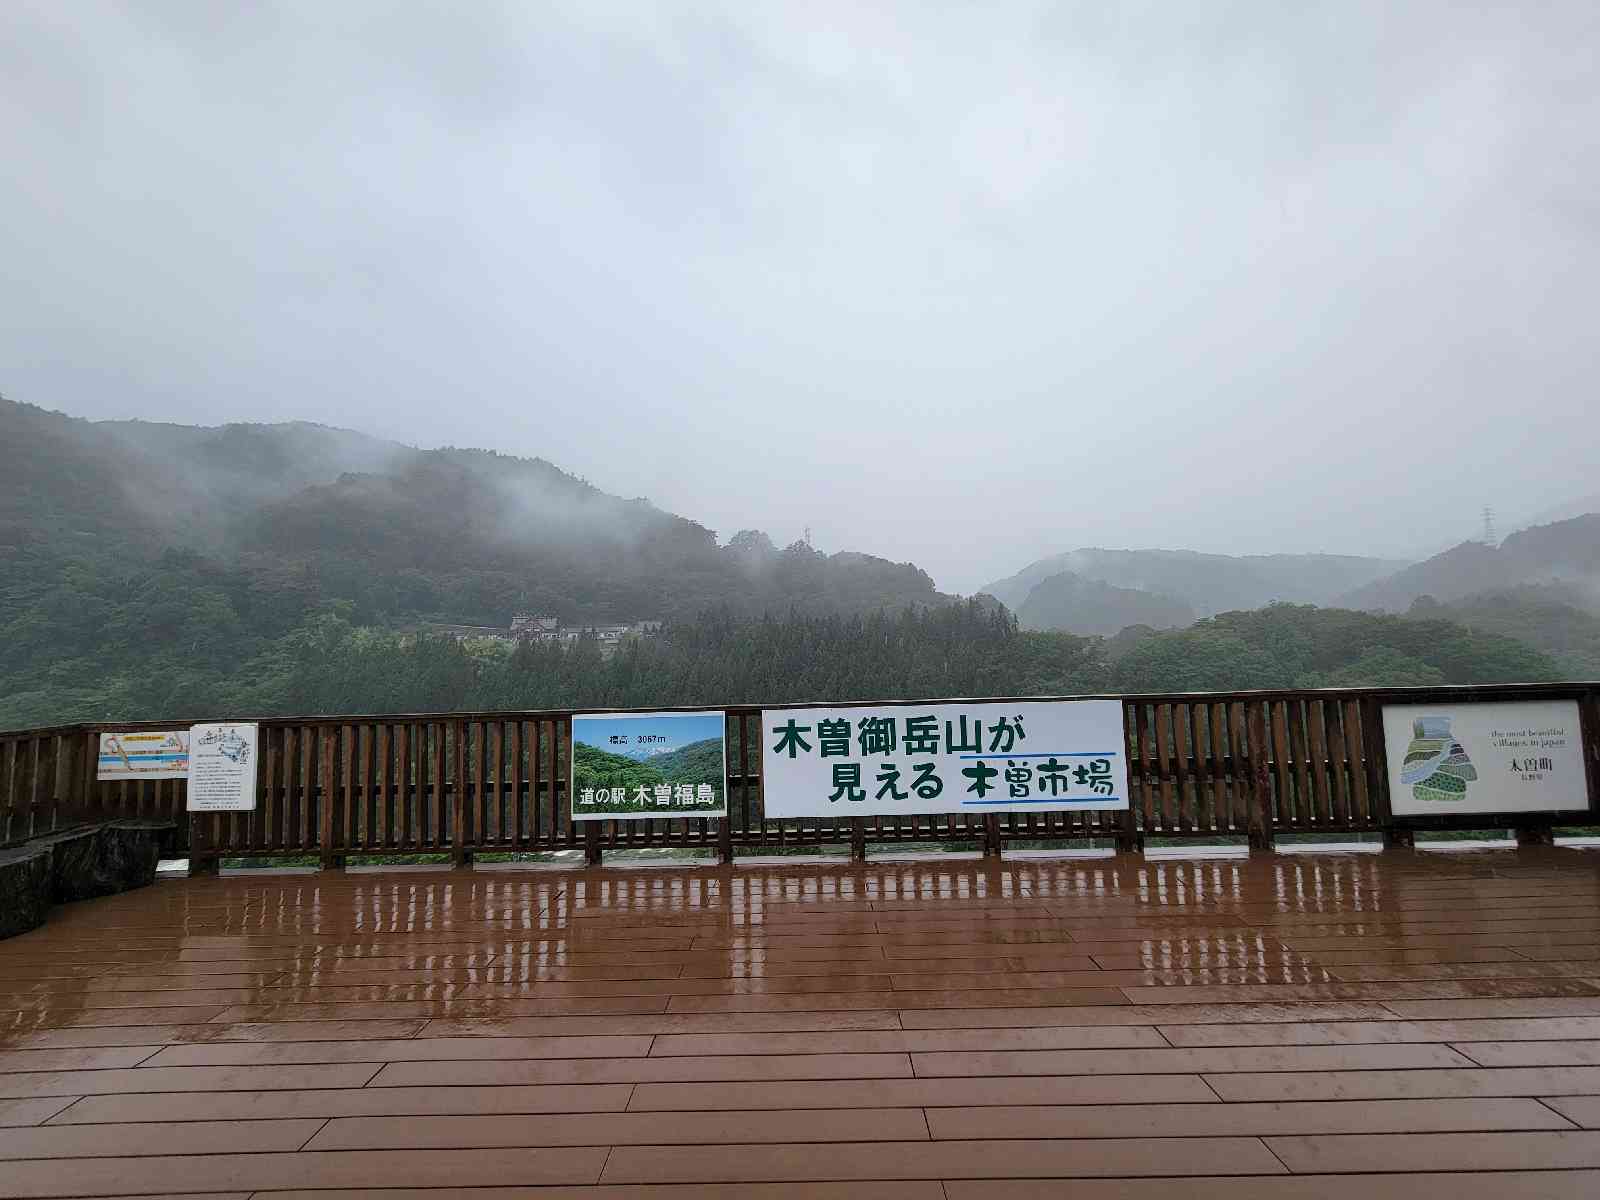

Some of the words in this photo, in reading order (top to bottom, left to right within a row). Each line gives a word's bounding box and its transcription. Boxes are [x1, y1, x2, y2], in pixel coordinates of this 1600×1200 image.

[609, 735, 628, 745] 標高
[772, 714, 1027, 759] 木曽御岳山が
[580, 787, 626, 805] 道の駅
[632, 782, 716, 806] 木曽福島
[828, 762, 944, 802] 見える
[961, 757, 1113, 799] 木曽市場
